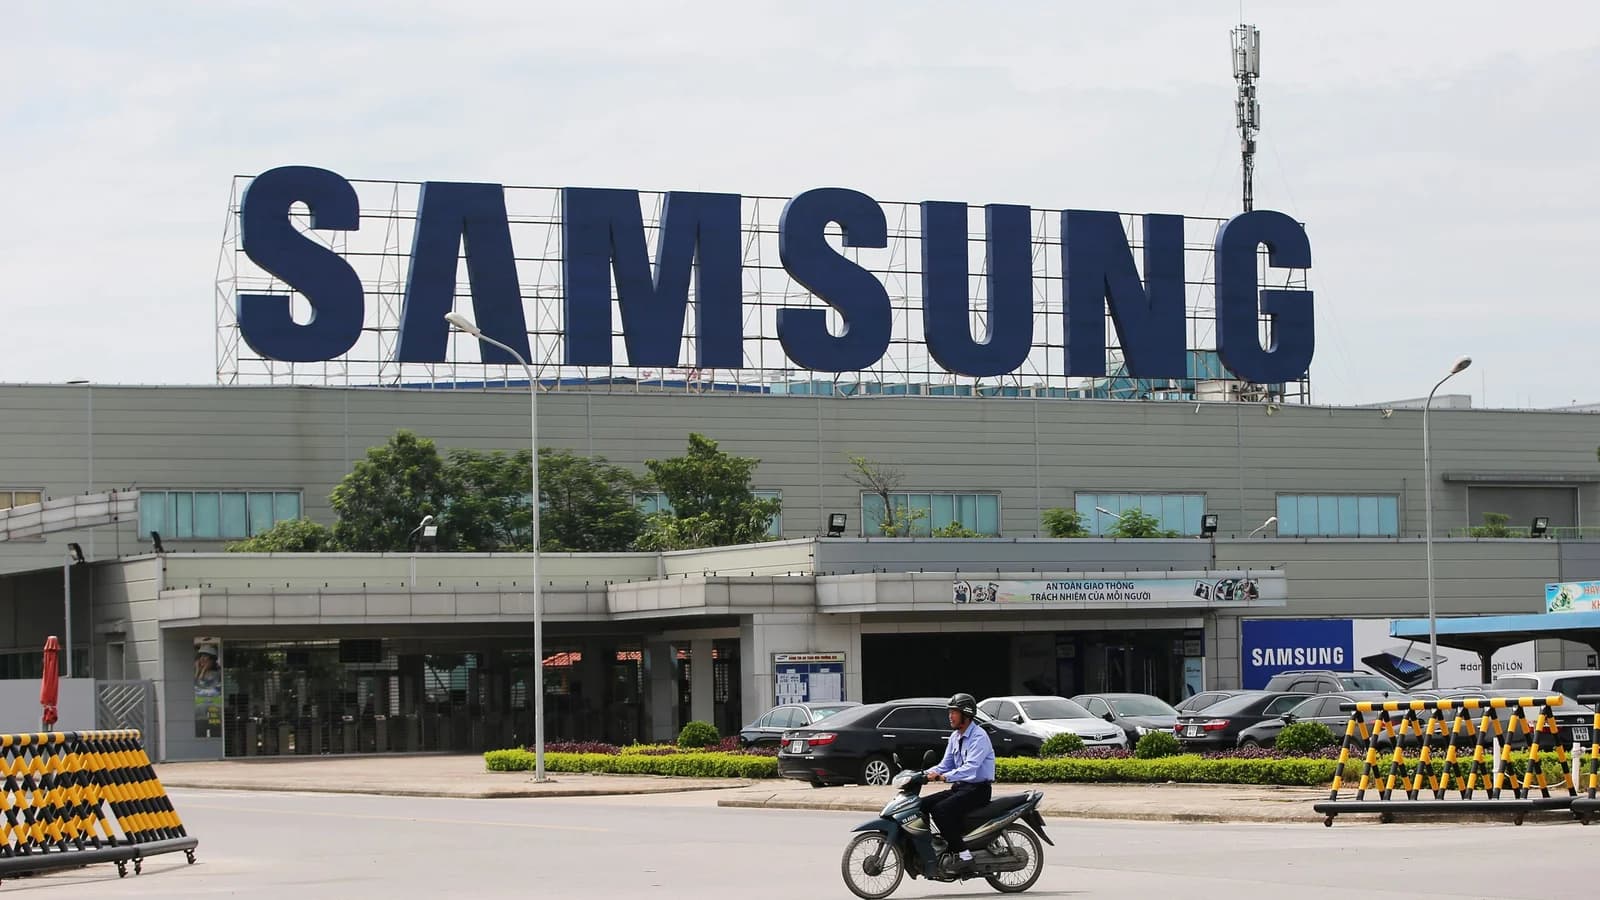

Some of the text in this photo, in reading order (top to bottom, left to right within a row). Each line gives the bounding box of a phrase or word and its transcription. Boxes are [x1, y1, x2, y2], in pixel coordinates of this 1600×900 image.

[237, 166, 1315, 384] SAMSUNG
[1046, 580, 1135, 590] AN TOÀN GIAO THÔNG
[1031, 591, 1058, 600] TRÁCH
[1088, 591, 1105, 600] CỦA
[1106, 590, 1123, 600] MỖI
[1124, 591, 1151, 600] NGƯỜI
[1252, 647, 1344, 666] SAMSUNG
